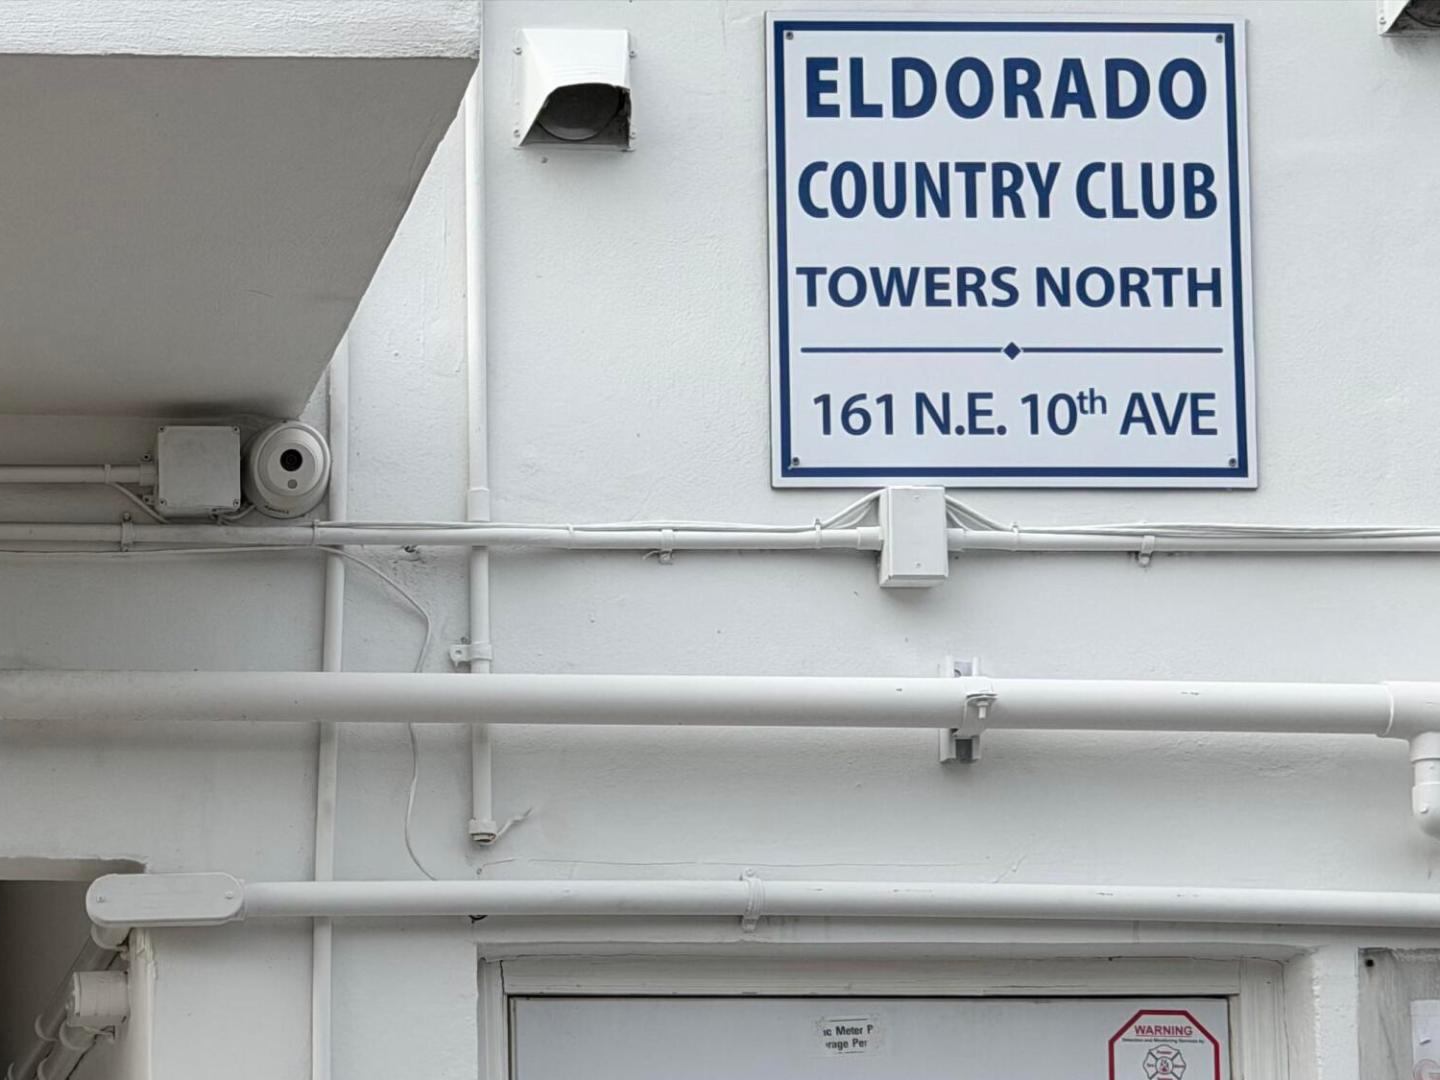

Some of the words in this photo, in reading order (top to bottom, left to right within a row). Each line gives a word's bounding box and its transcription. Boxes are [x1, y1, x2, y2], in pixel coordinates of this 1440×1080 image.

[805, 56, 1207, 120] ELDORADO
[797, 160, 1062, 219] COUNTRY
[1075, 161, 1218, 220] CLUB
[795, 266, 1020, 308] TOWERS
[1035, 267, 1223, 308] NORTH
[813, 392, 894, 436] 161
[916, 392, 1007, 436] N.E.
[1021, 388, 1108, 436] 10th
[1119, 392, 1218, 436] AVE
[825, 1041, 849, 1050] rage
[835, 1026, 863, 1035] Meter
[1134, 1025, 1193, 1036] WARNING
